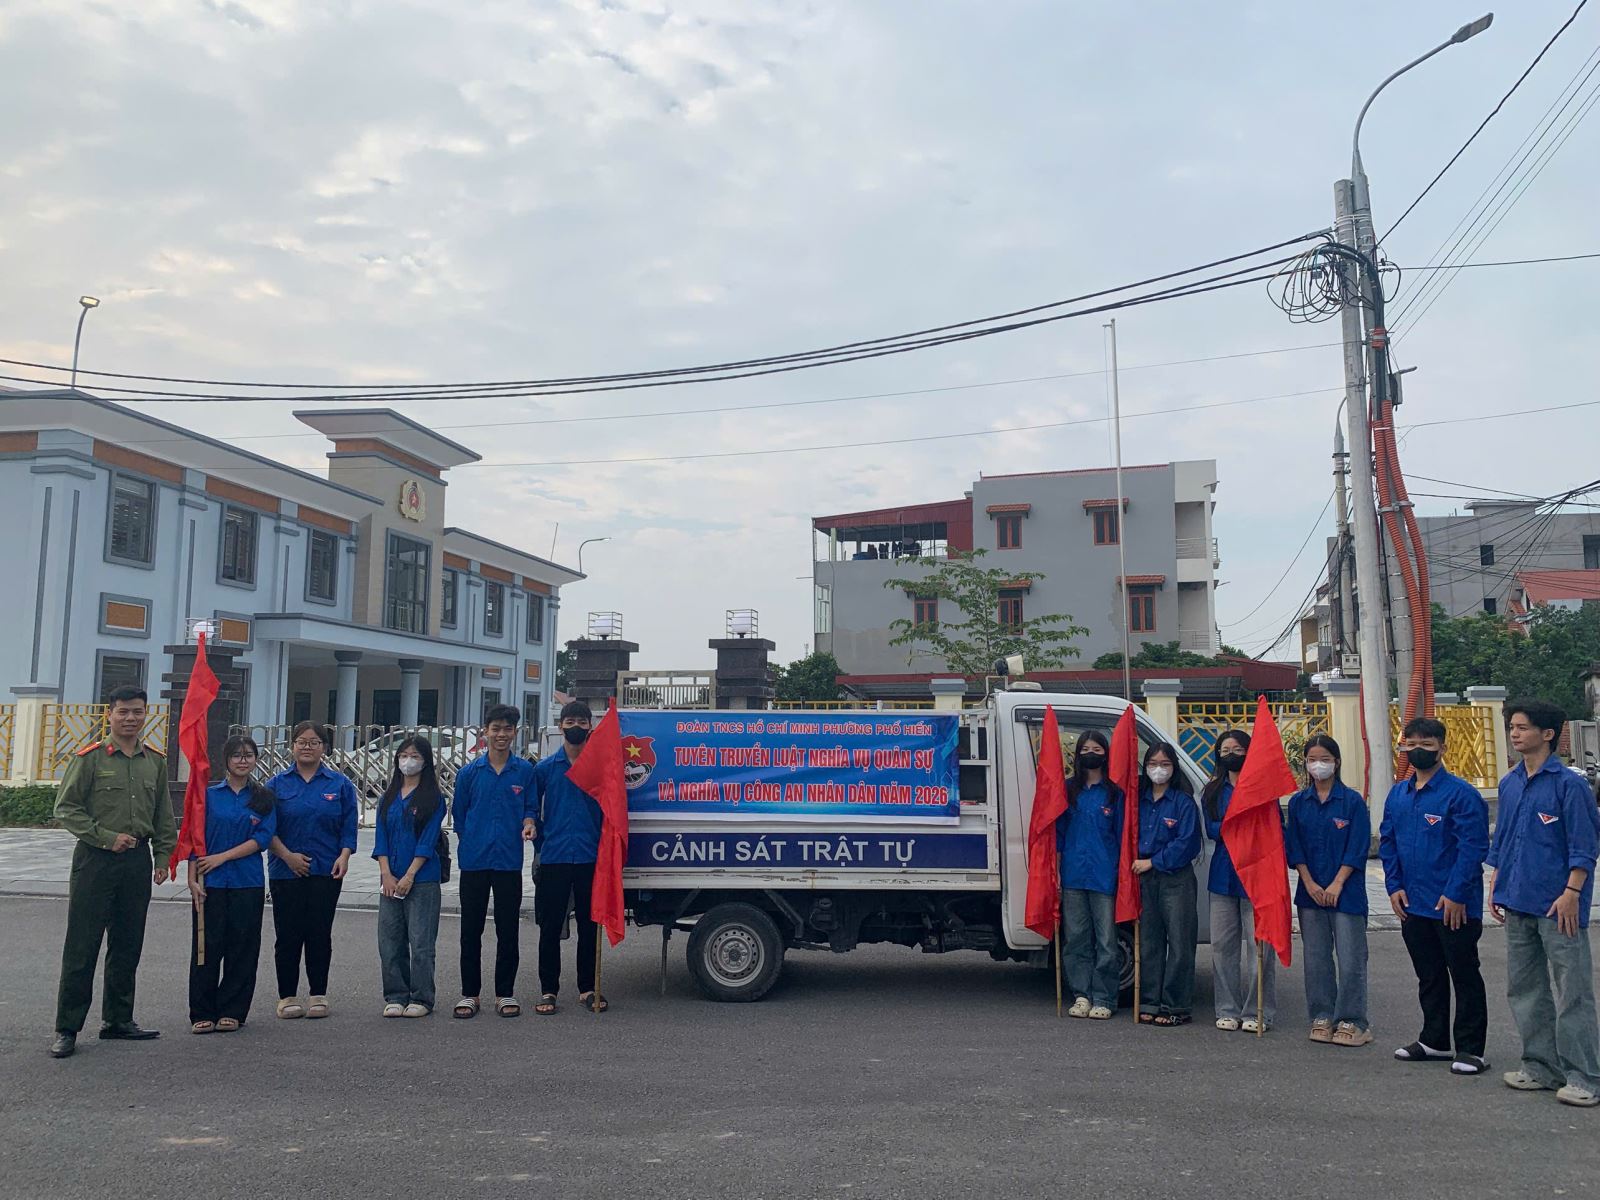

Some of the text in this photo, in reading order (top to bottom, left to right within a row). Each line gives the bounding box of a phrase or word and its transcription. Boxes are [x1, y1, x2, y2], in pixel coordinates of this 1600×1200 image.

[676, 719, 710, 733] ĐOÀN
[713, 722, 744, 733] TNCS
[767, 720, 787, 734] CHÍ
[790, 722, 819, 734] MINH
[823, 721, 872, 736] PHƯỜNG
[904, 721, 932, 736] HIẾN
[674, 744, 716, 767] TUYÊN
[773, 745, 805, 771] LUẬT
[809, 746, 849, 768] NGHĨA
[853, 749, 870, 772] VỤ
[874, 746, 911, 770] QUÂN
[914, 748, 934, 773] SỰ
[679, 779, 720, 802] NGHĨA
[724, 783, 741, 806] VỤ
[744, 779, 781, 802] CÔNG
[785, 783, 803, 802] AN
[807, 780, 844, 803] NHÂN
[848, 782, 876, 804] DÂN
[880, 782, 911, 804] NĂM
[915, 786, 948, 805] 2026
[652, 834, 915, 866] CẢNH SÁT TRẬT TỰ
